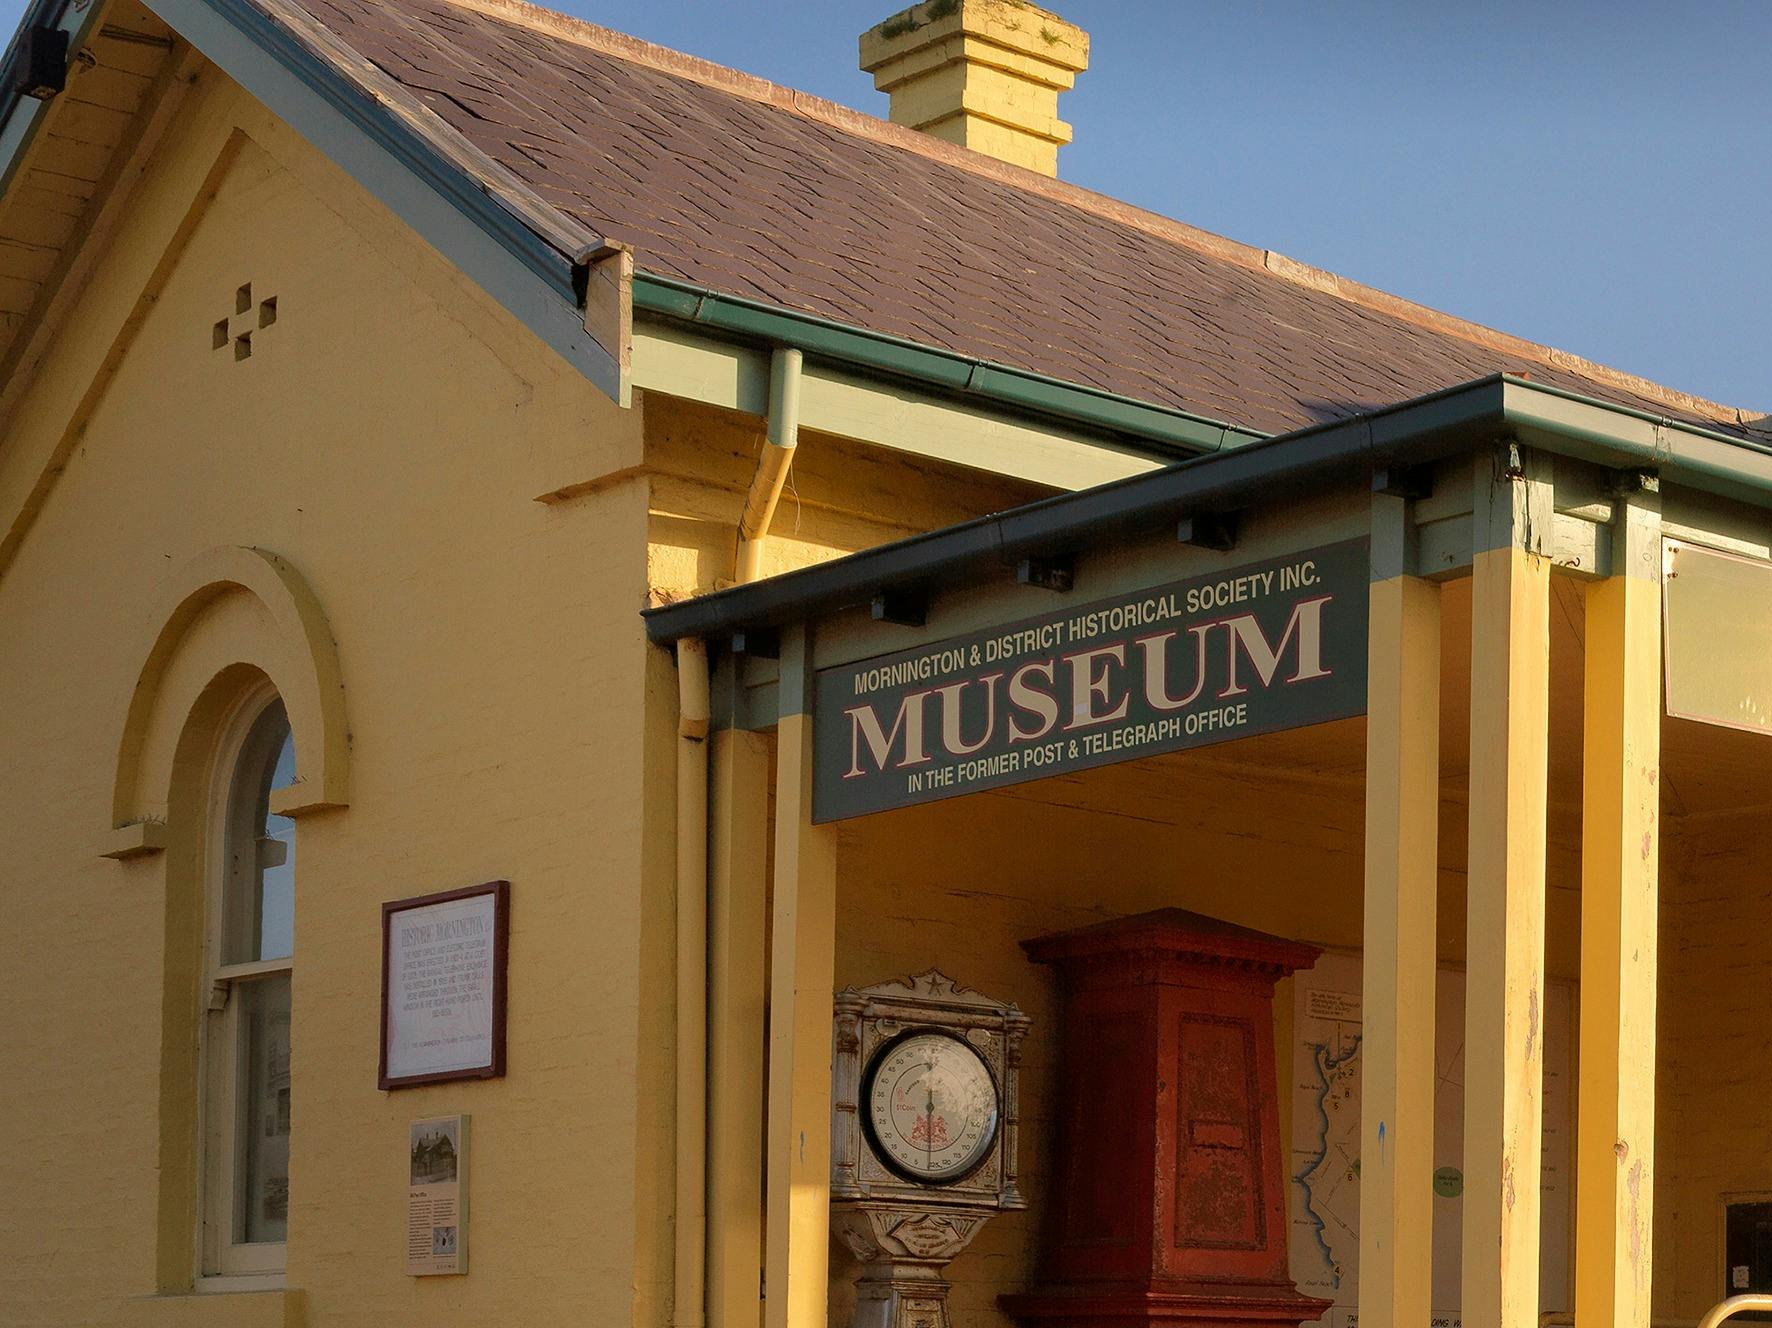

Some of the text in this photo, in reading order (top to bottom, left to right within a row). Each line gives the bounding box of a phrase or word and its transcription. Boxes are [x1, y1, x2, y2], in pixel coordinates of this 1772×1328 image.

[842, 596, 1333, 779] MUSEUM
[854, 560, 1321, 696] MORNINGTON & DISTRICT HISTORICAL SOCIETY INC.
[907, 703, 1247, 794] IN THE FORMER POST & TELEGRAPH OFFICE
